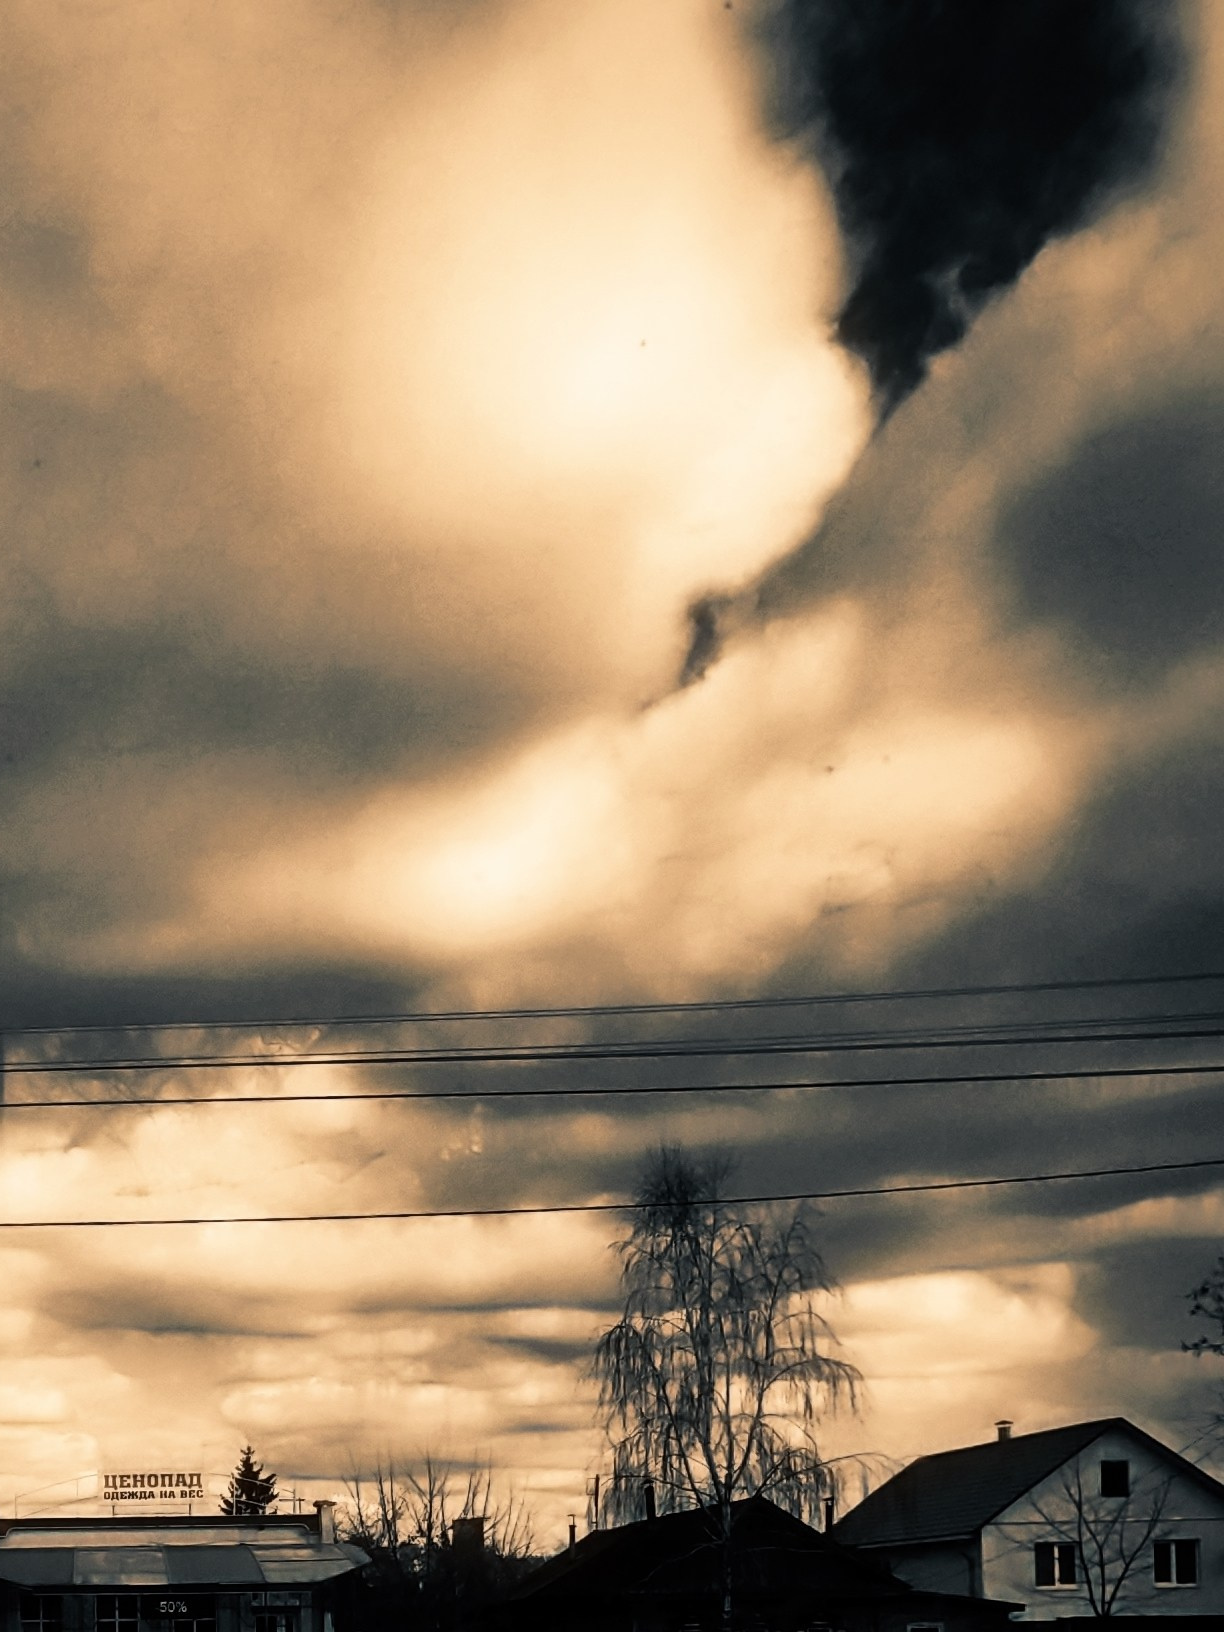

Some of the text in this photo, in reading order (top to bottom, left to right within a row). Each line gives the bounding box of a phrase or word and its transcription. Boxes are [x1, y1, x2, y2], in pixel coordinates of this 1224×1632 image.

[104, 1473, 202, 1490] ЦЕНОПАД
[104, 1489, 204, 1500] ОДЕЖДА НА ВЕС
